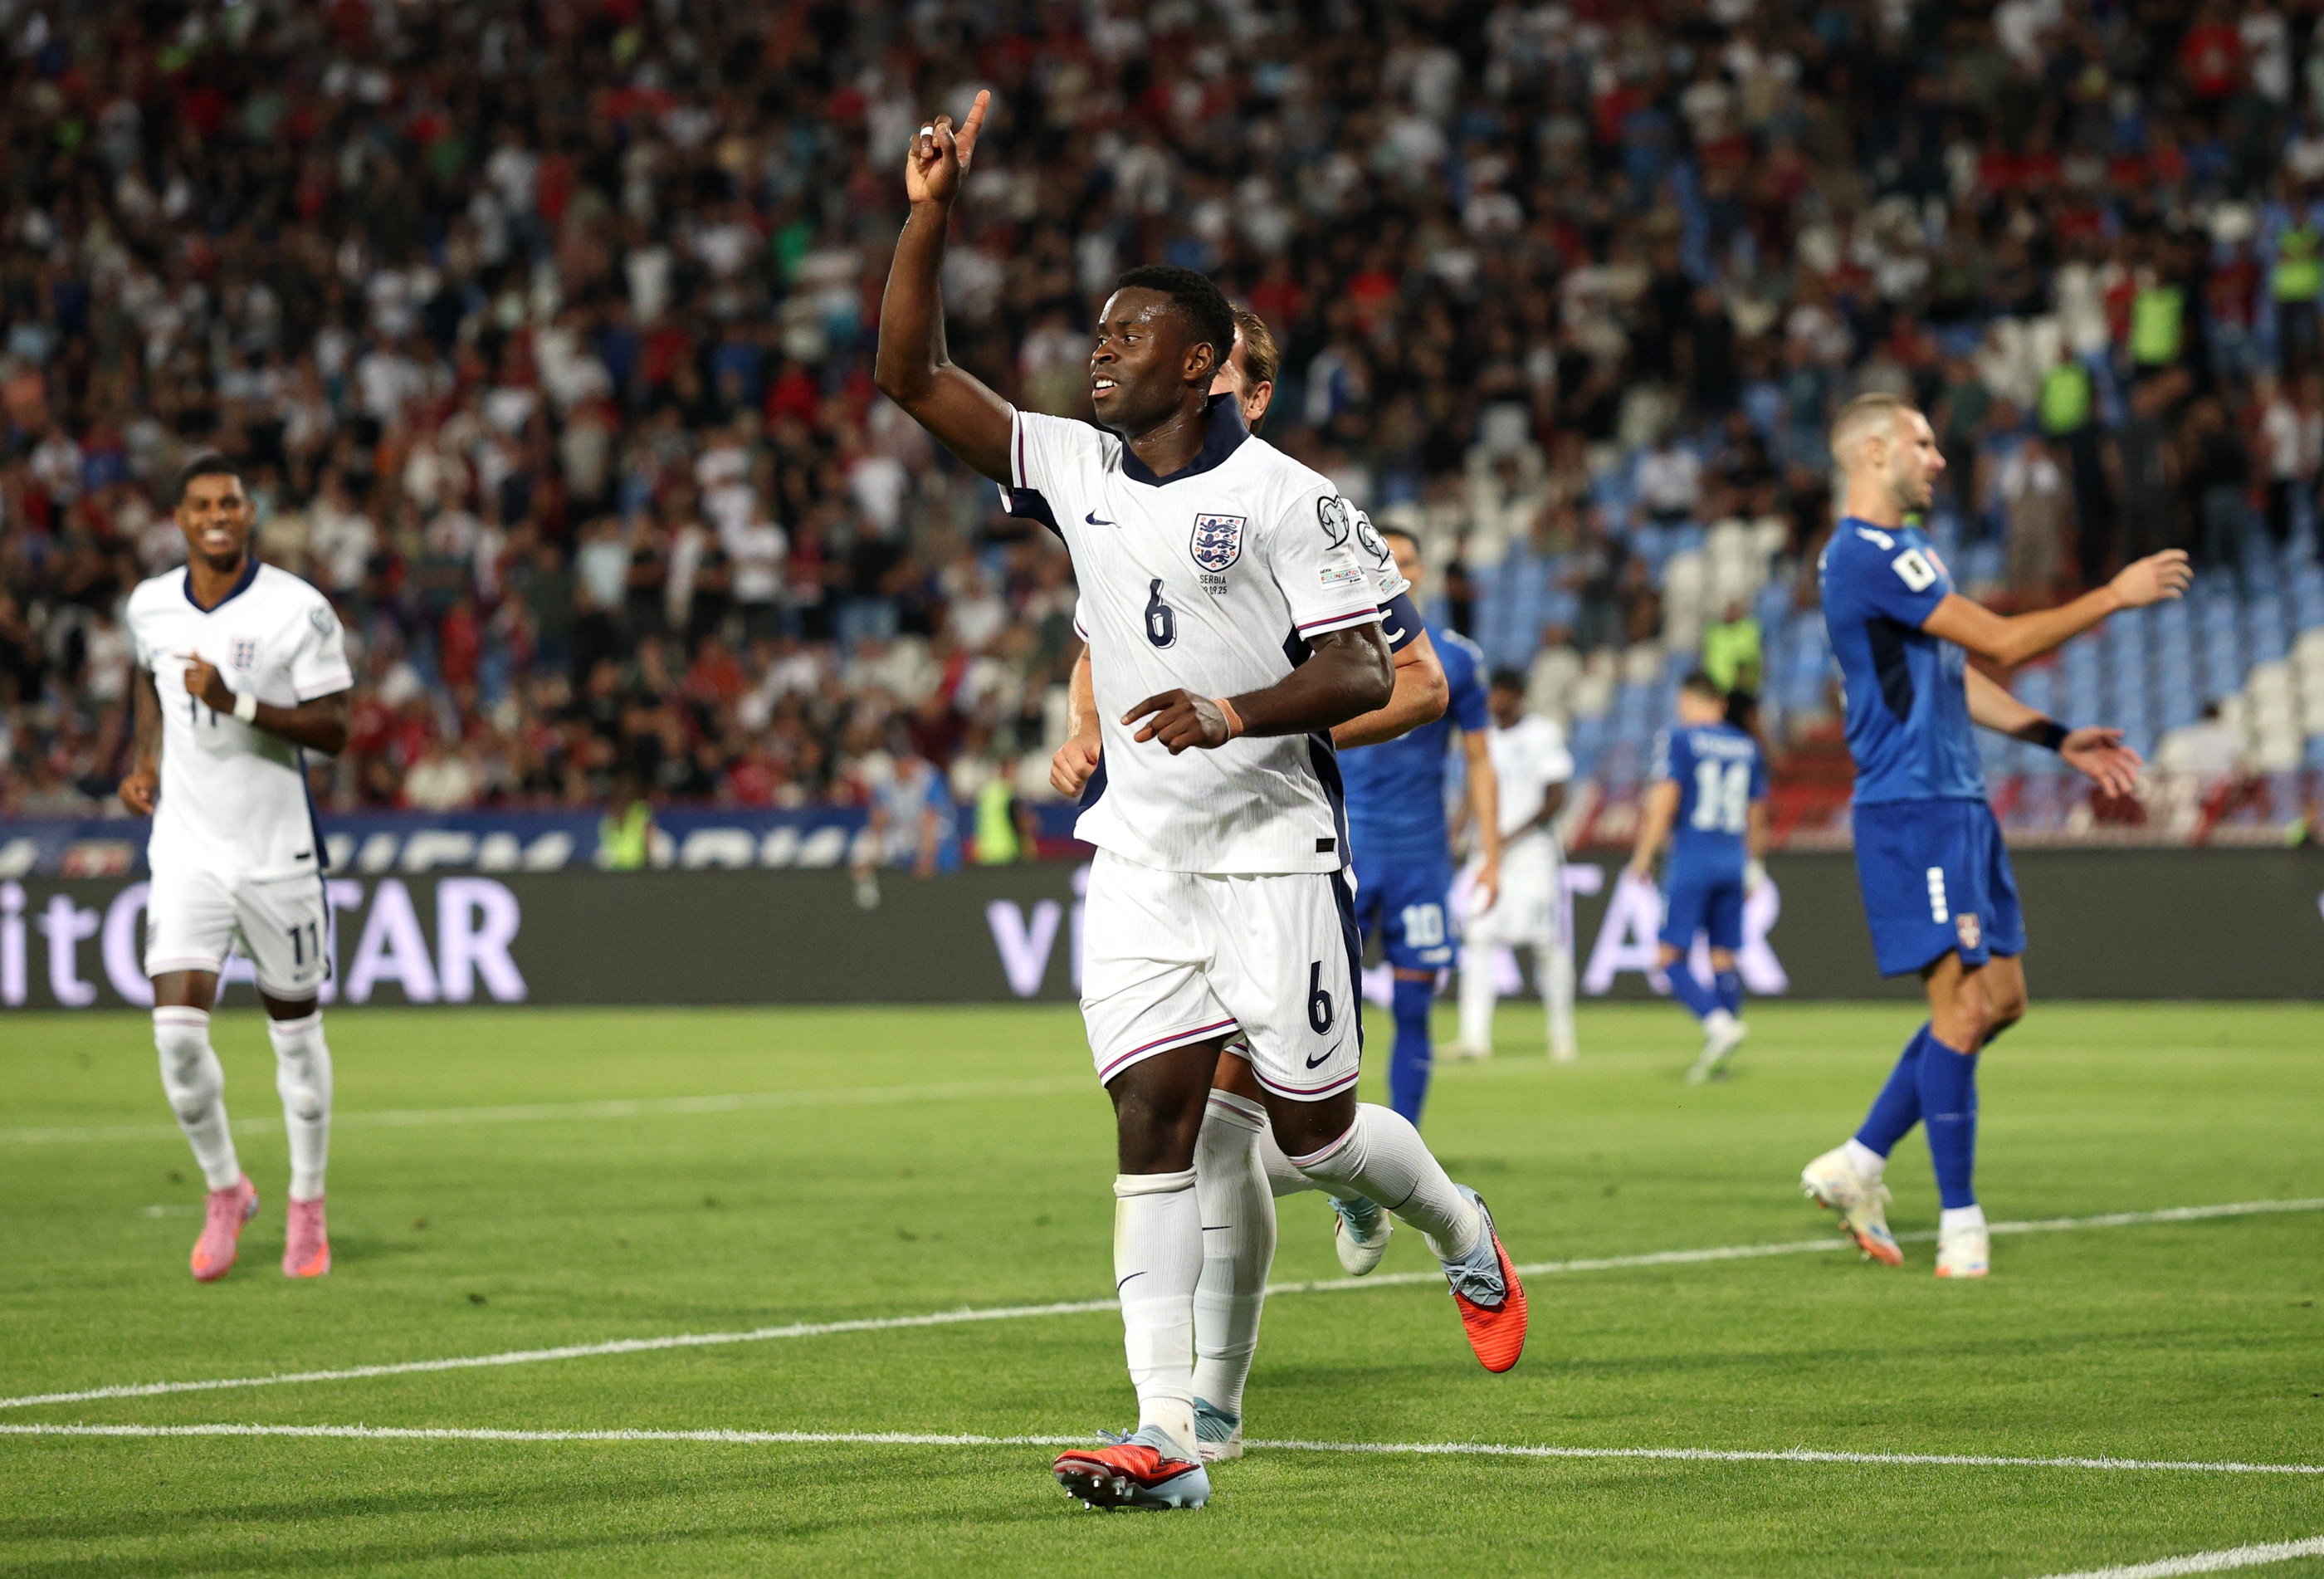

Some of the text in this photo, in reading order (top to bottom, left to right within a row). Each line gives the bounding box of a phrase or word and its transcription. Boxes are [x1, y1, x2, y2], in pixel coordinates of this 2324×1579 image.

[1199, 574, 1227, 584] SERBIA
[1145, 578, 1177, 649] 6
[1379, 608, 1406, 644] C
[1691, 760, 1750, 833] 14
[287, 922, 319, 966] 11
[1402, 903, 1445, 947] 10
[1307, 960, 1335, 1036] 6
